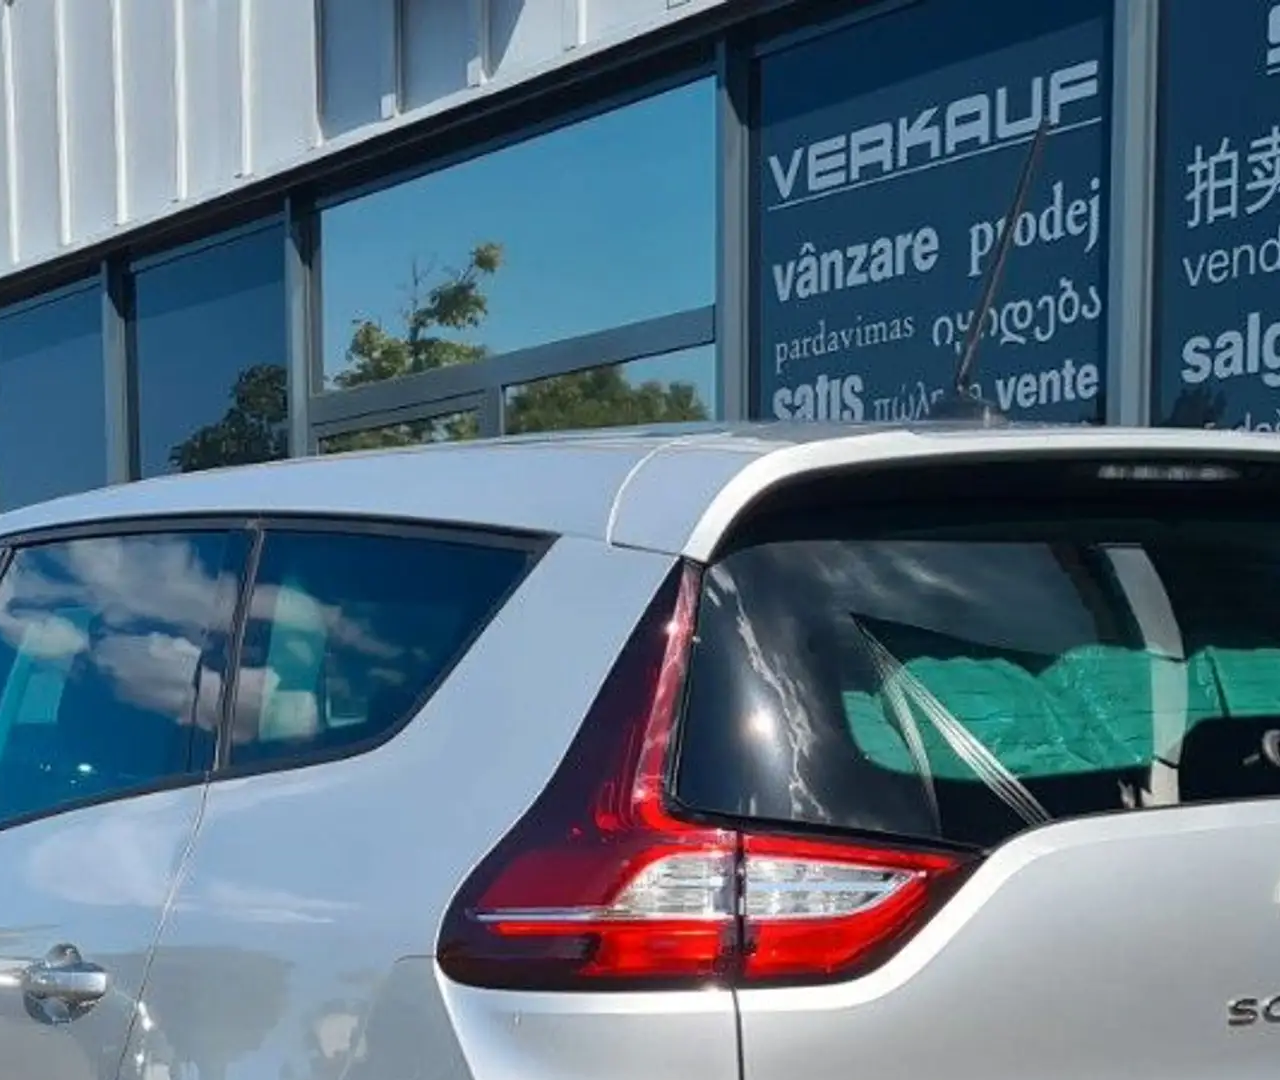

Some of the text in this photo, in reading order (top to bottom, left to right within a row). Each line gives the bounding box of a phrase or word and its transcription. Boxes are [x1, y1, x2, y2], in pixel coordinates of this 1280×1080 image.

[768, 60, 1099, 200] VERKAUF
[772, 226, 940, 302] vânzare
[775, 314, 915, 374] pardavimas
[995, 359, 1099, 411] vente
